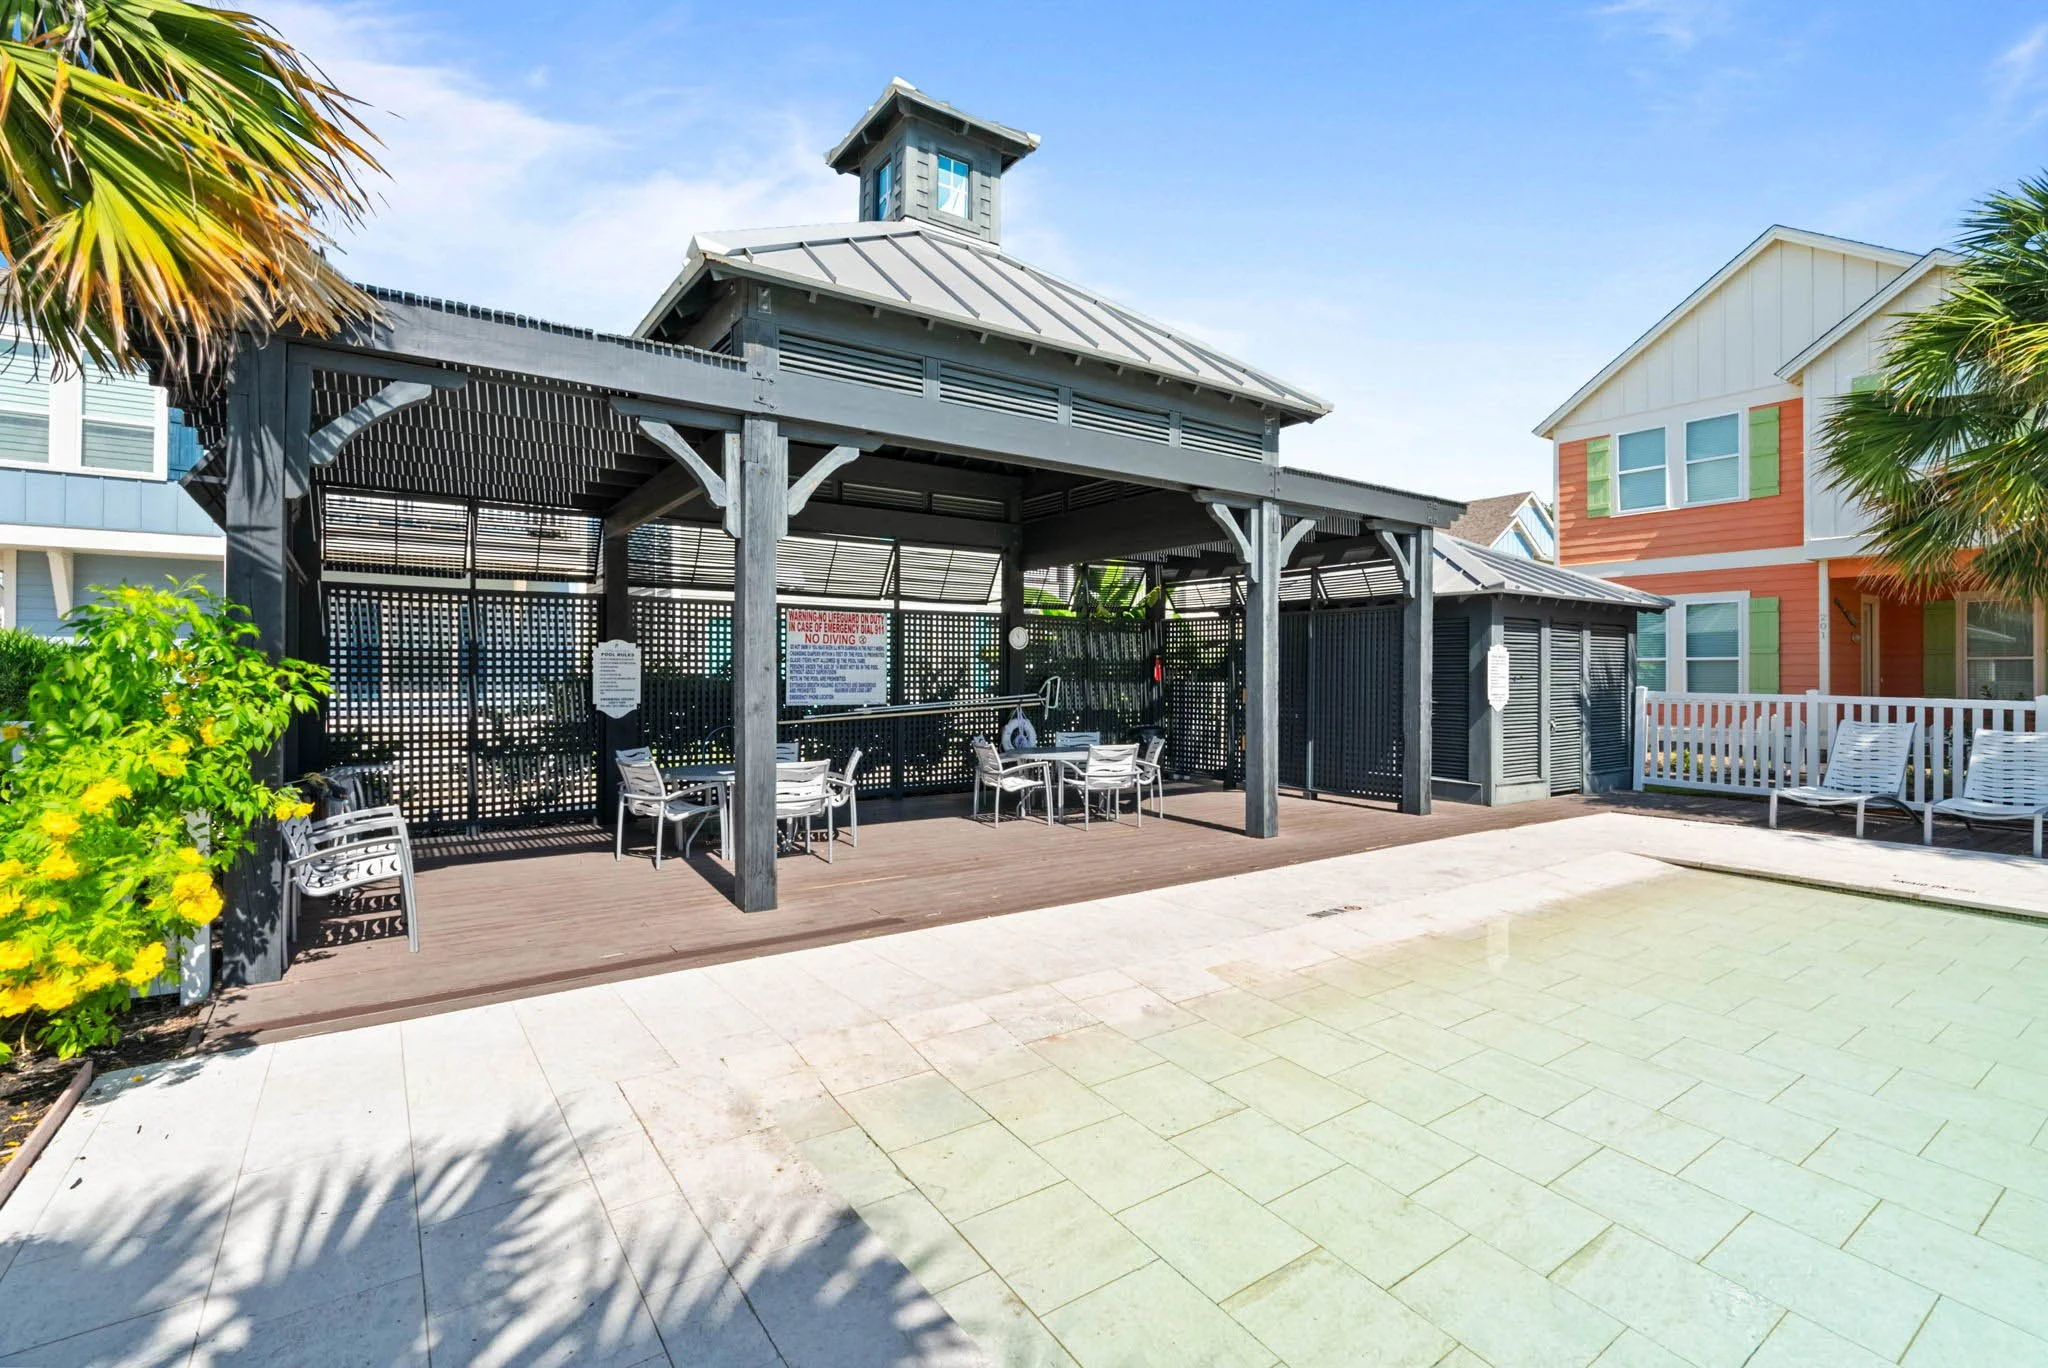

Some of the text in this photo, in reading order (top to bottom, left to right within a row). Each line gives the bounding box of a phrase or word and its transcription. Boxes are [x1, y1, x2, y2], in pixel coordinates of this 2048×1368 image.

[828, 613, 860, 623] LIFEGUARD
[861, 614, 869, 624] ON
[870, 614, 884, 625] DUTY
[788, 622, 885, 635] IN CASE OF EMERGENCY DIAL 911
[805, 634, 856, 645] NO DIVING
